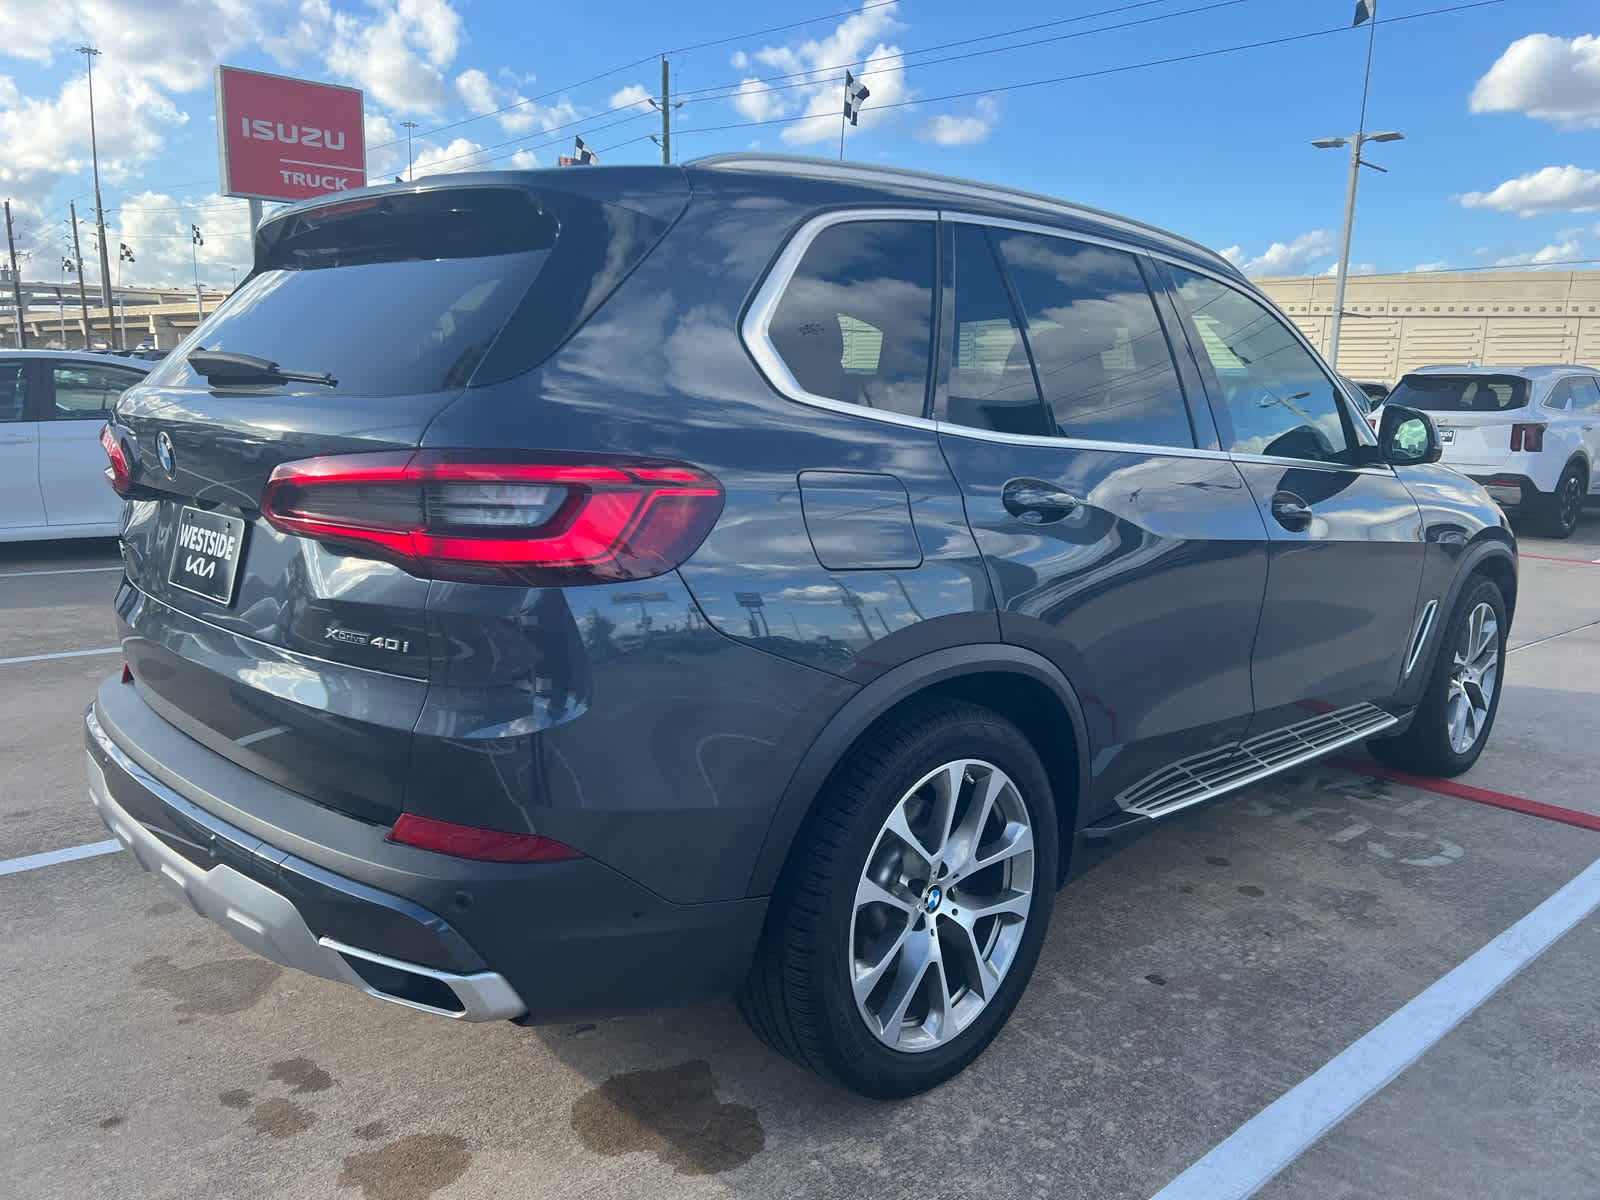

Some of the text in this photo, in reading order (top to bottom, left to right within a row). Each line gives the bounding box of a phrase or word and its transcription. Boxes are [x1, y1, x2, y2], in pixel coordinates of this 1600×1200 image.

[241, 117, 345, 150] ISUZU
[279, 170, 349, 191] TRUCK
[179, 523, 236, 561] WESTSIDE
